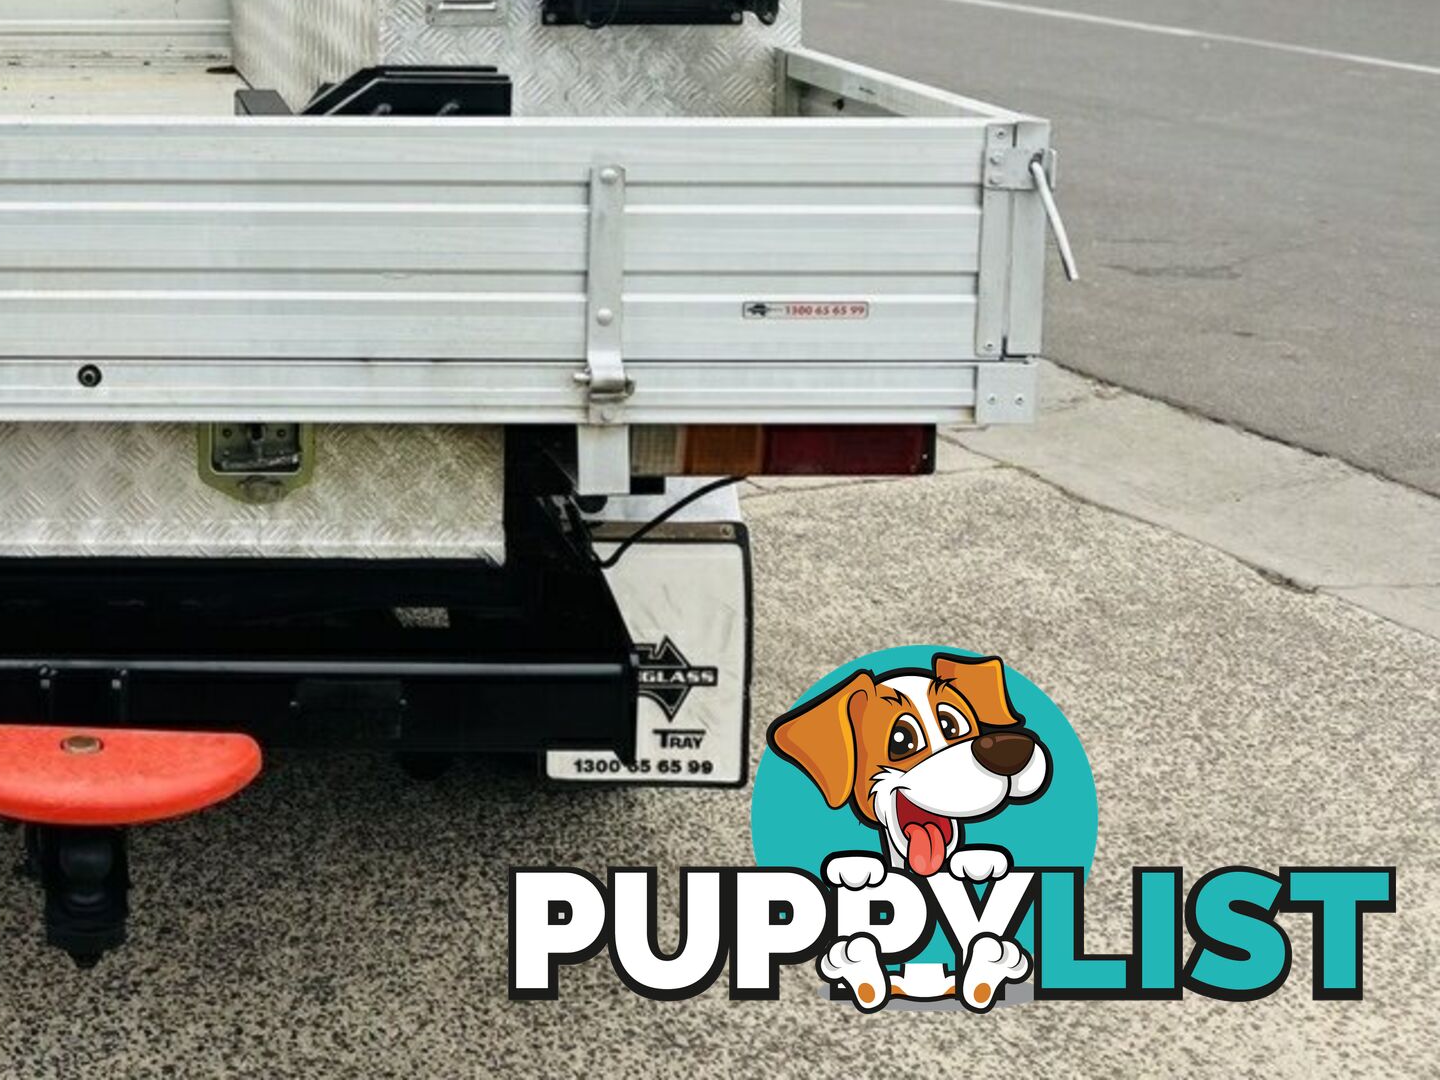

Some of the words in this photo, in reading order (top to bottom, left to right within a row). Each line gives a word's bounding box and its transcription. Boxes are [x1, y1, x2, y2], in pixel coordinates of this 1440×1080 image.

[785, 306, 812, 316] 1300
[814, 306, 830, 316] 65
[832, 306, 847, 316] 65
[850, 306, 865, 315] 99
[653, 729, 706, 749] TRAY
[573, 759, 620, 774] 1300
[657, 759, 682, 774] 65
[687, 760, 713, 775] 99
